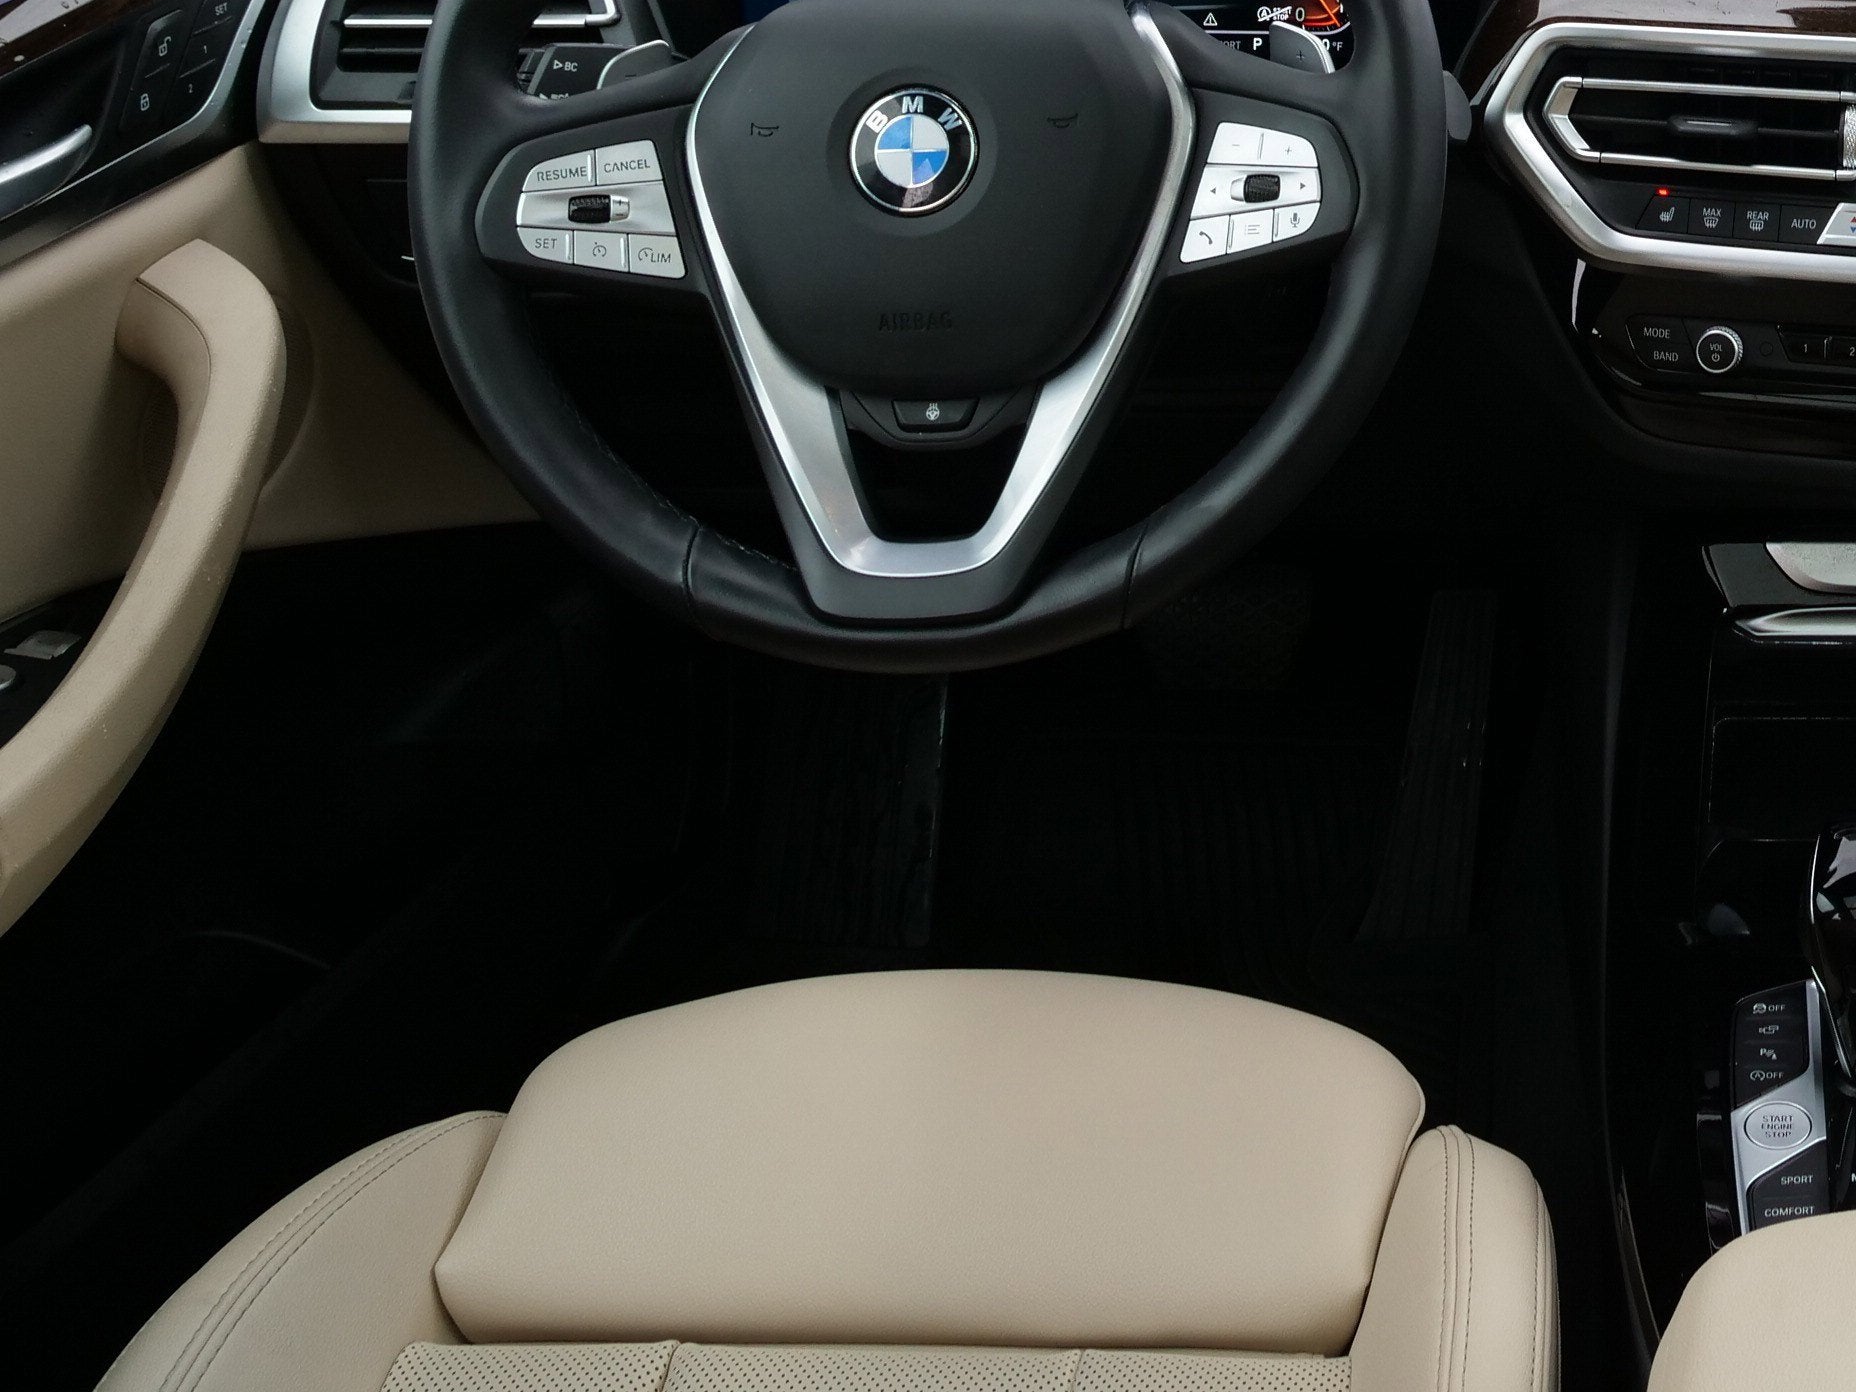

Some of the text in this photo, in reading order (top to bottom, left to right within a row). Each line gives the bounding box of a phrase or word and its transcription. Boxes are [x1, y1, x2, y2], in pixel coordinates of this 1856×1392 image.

[214, 2, 228, 16] SET
[1295, 6, 1305, 22] 0
[203, 44, 208, 54] 1
[1252, 37, 1263, 51] P
[564, 61, 578, 73] BC
[188, 83, 194, 94] 2
[866, 95, 963, 134] BMW
[603, 158, 651, 175] CANCEL
[537, 165, 588, 182] RESUME
[1702, 207, 1722, 218] MAX
[1746, 210, 1770, 222] REAR
[1791, 218, 1817, 230] AUTO
[534, 238, 558, 250] SET
[650, 253, 672, 264] LIM
[878, 311, 953, 331] AIRBAG
[1643, 326, 1671, 339] MODE
[1709, 343, 1723, 352] VOL
[1803, 343, 1808, 353] 1
[1849, 347, 1856, 357] 2
[1653, 350, 1679, 362] BAND
[1768, 1004, 1786, 1012] OFF
[1766, 1071, 1784, 1079] OFF
[1762, 1114, 1793, 1123] START
[1760, 1122, 1794, 1131] ENGINE
[1764, 1130, 1792, 1139] STOP
[1780, 1174, 1814, 1186] SPORT
[1764, 1205, 1815, 1217] COMFORT
